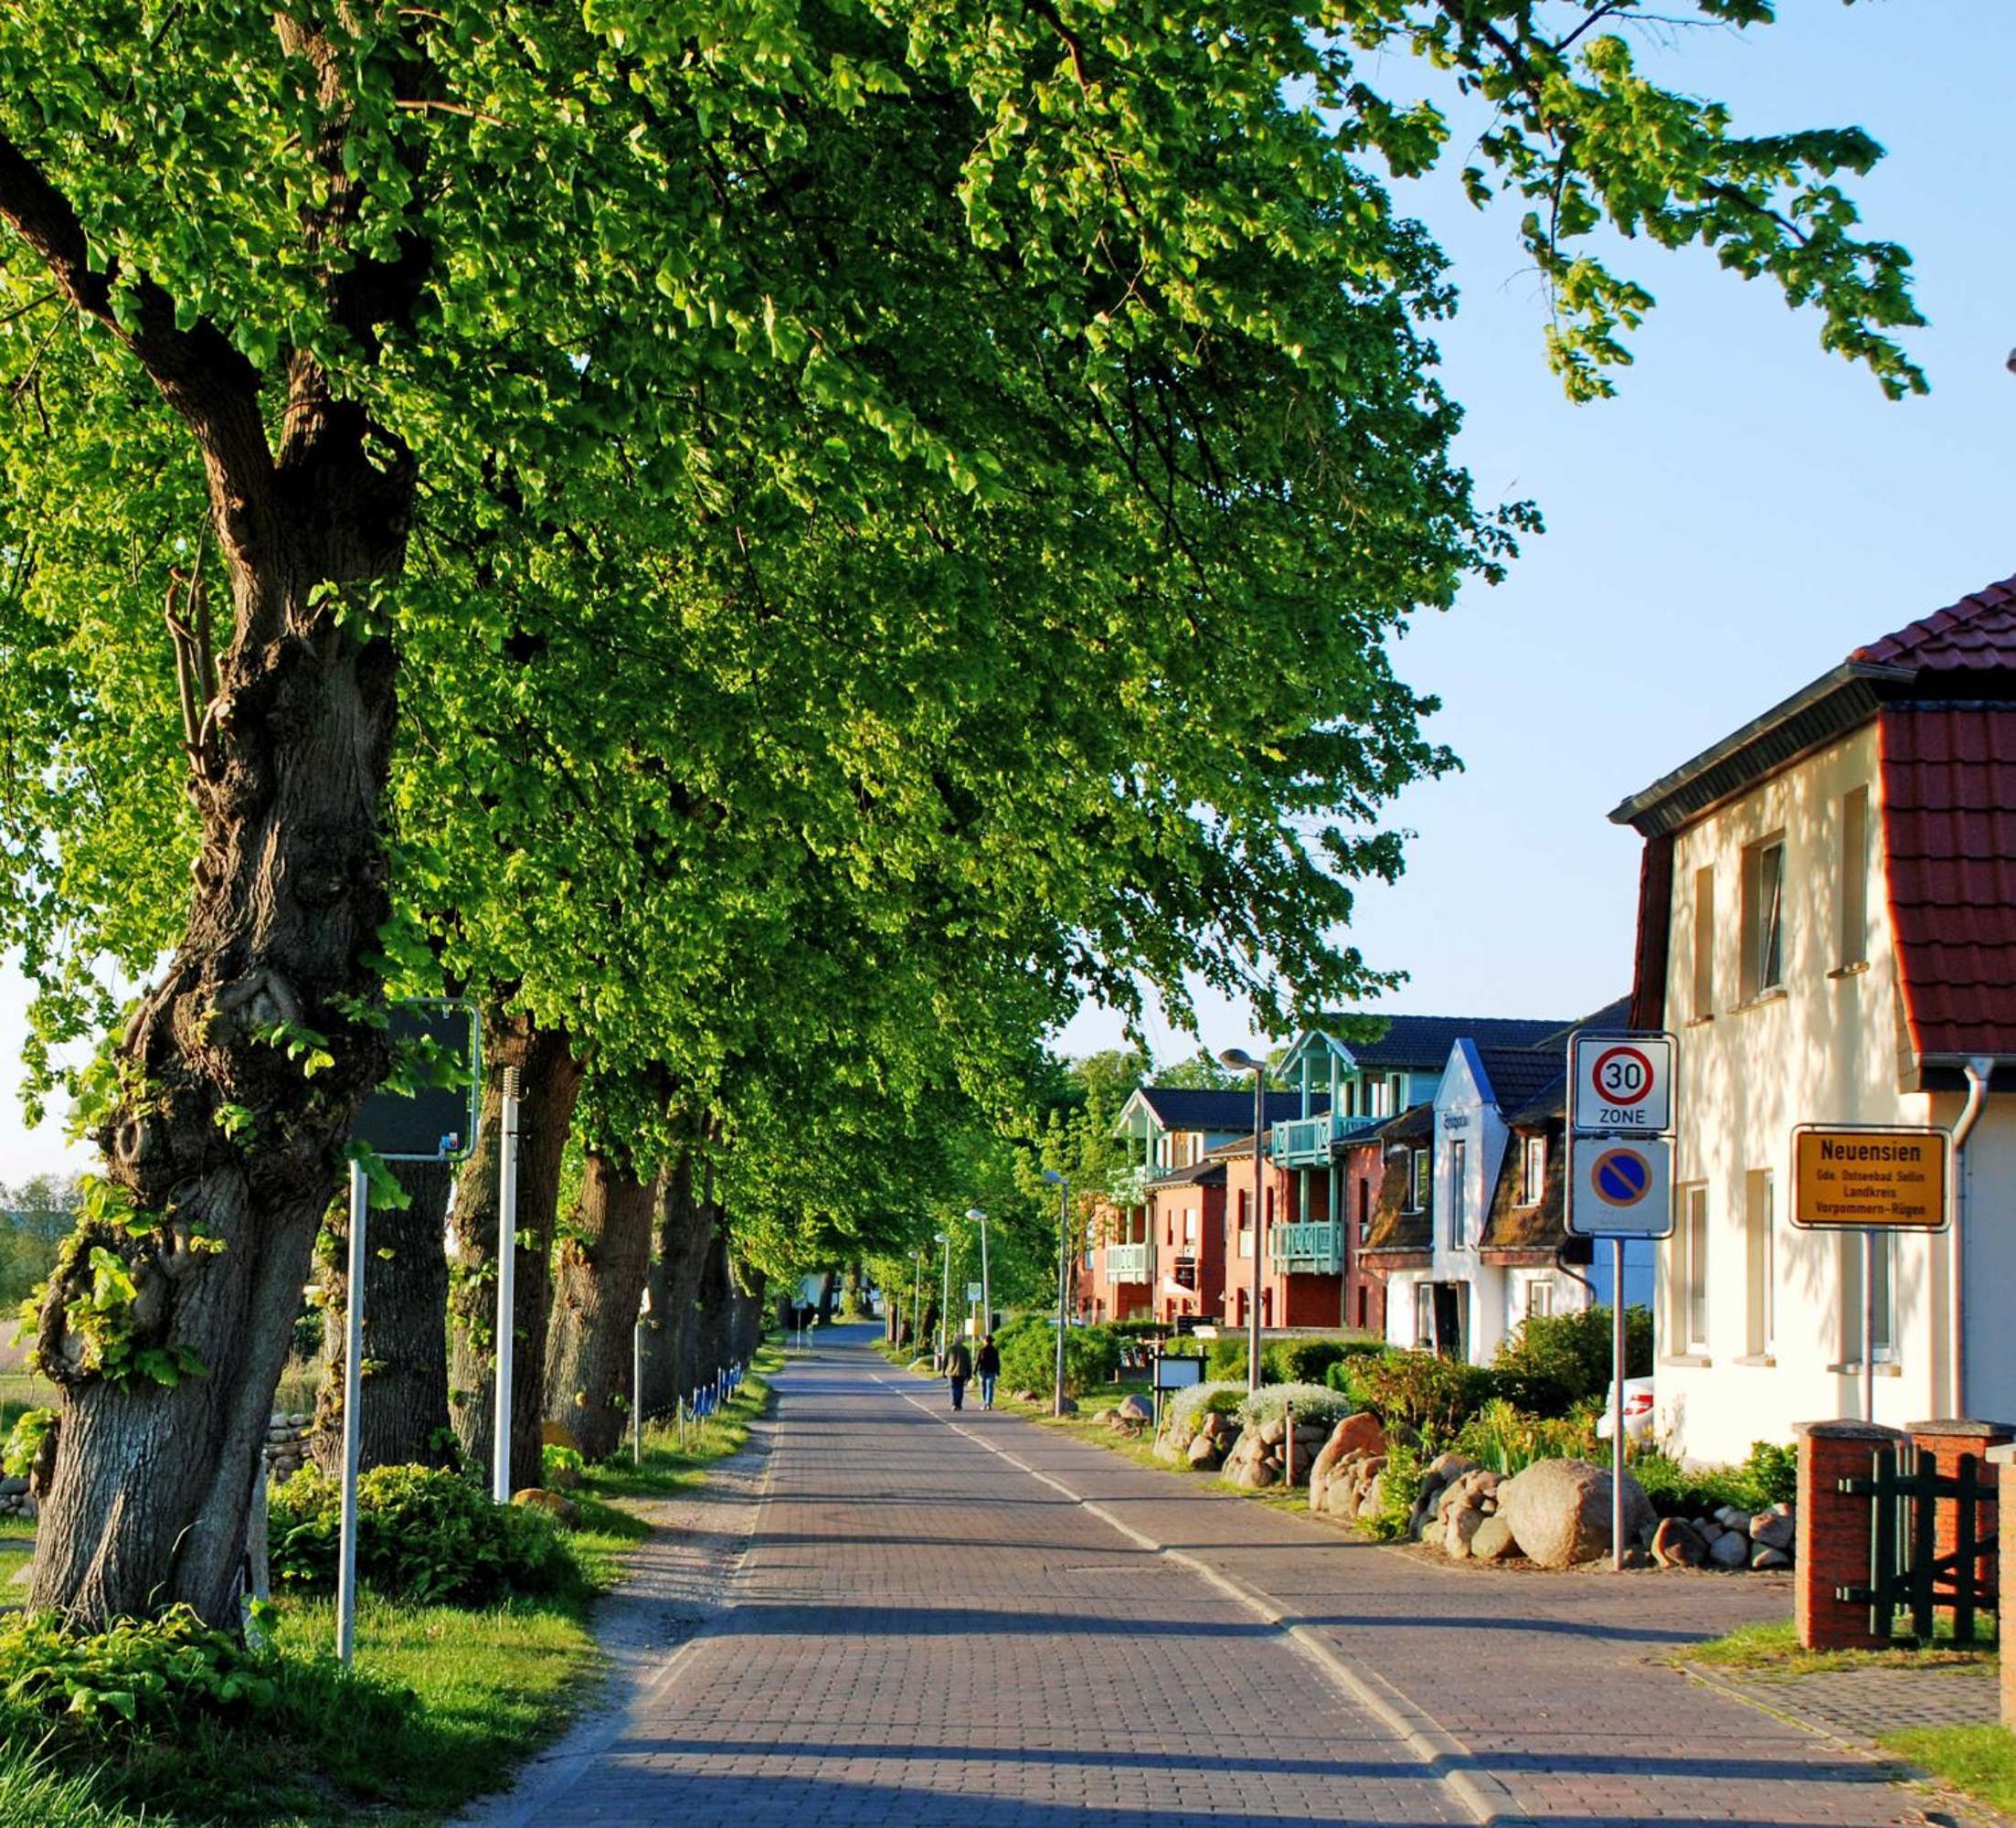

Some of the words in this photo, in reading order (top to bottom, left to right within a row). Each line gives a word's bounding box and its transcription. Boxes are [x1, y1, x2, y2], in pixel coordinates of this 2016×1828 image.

[1605, 1063, 1640, 1089] 30
[1599, 1109, 1646, 1124] ZONE
[1820, 1140, 1921, 1162] Neuensien
[1843, 1185, 1896, 1198] Landkreis
[1815, 1201, 1926, 1218] Vorpommern-Rügen
